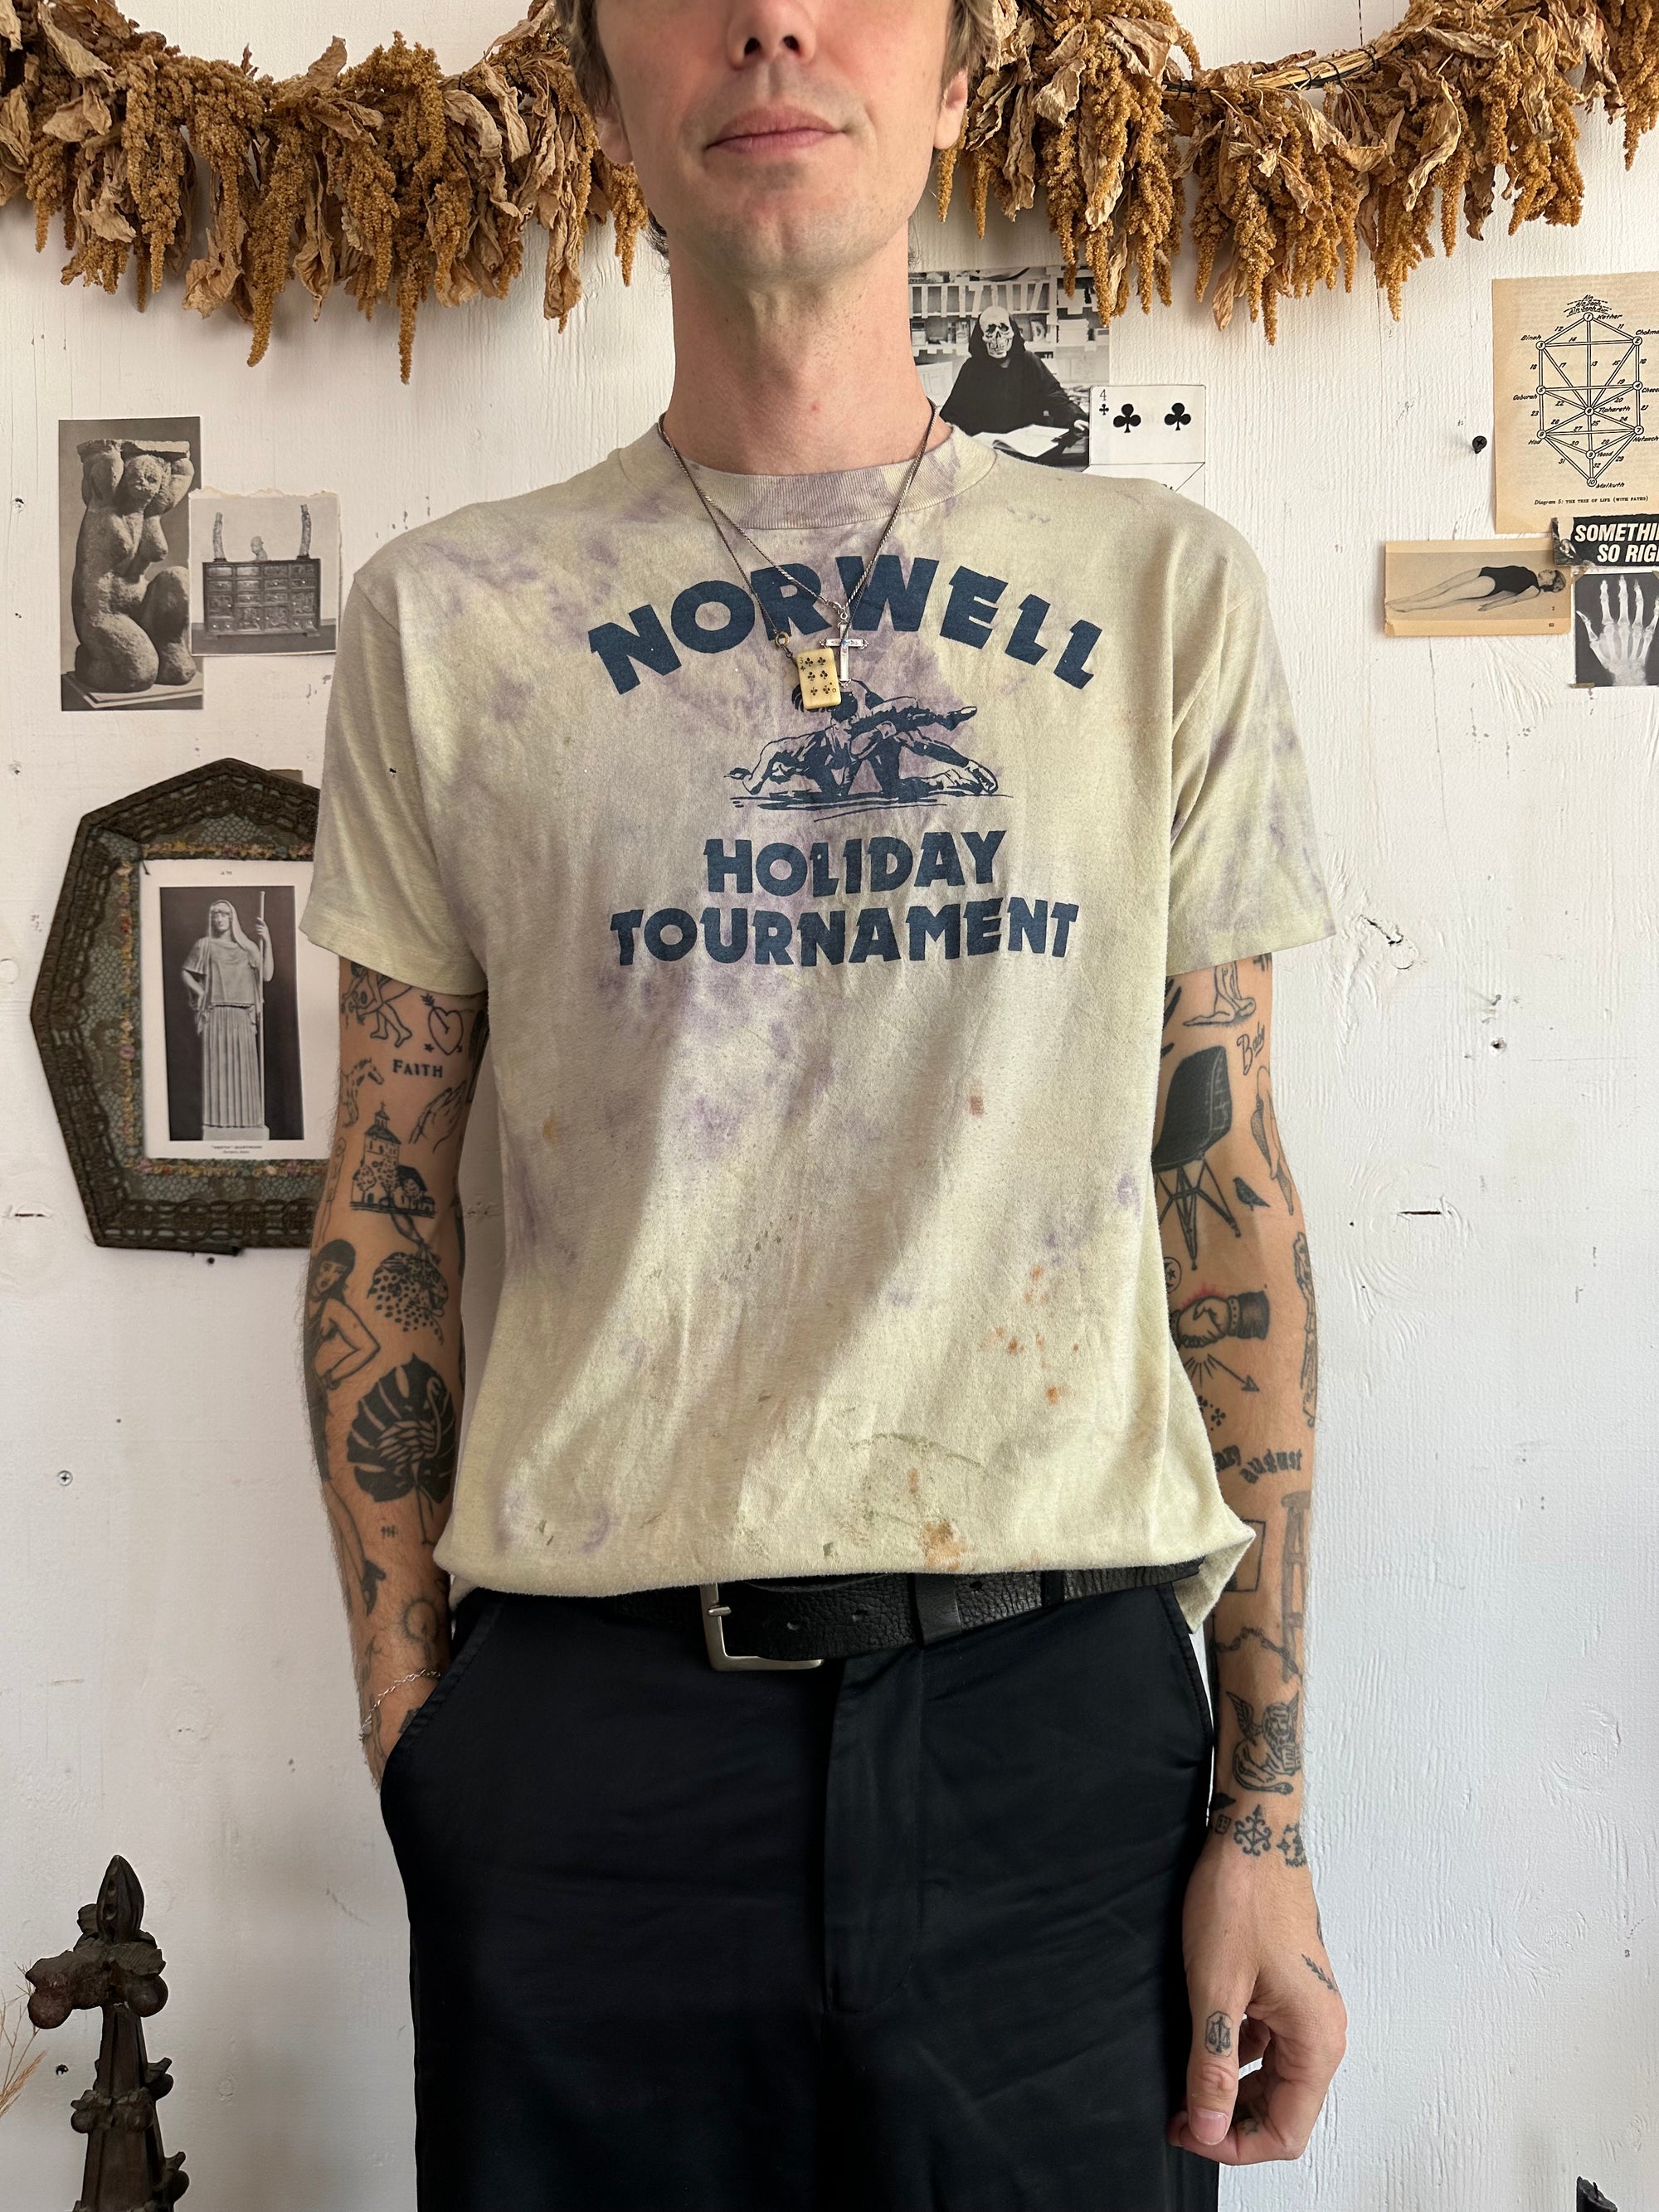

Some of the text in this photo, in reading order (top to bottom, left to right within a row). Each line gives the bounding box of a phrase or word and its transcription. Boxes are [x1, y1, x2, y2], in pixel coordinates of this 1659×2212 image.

[1099, 388, 1107, 401] 4
[1597, 543, 1621, 563] SO
[588, 555, 1103, 695] NORWELL
[703, 829, 1007, 898] HOLIDAY
[610, 897, 1079, 967] TOURNAMENT
[392, 1058, 443, 1078] FAITH
